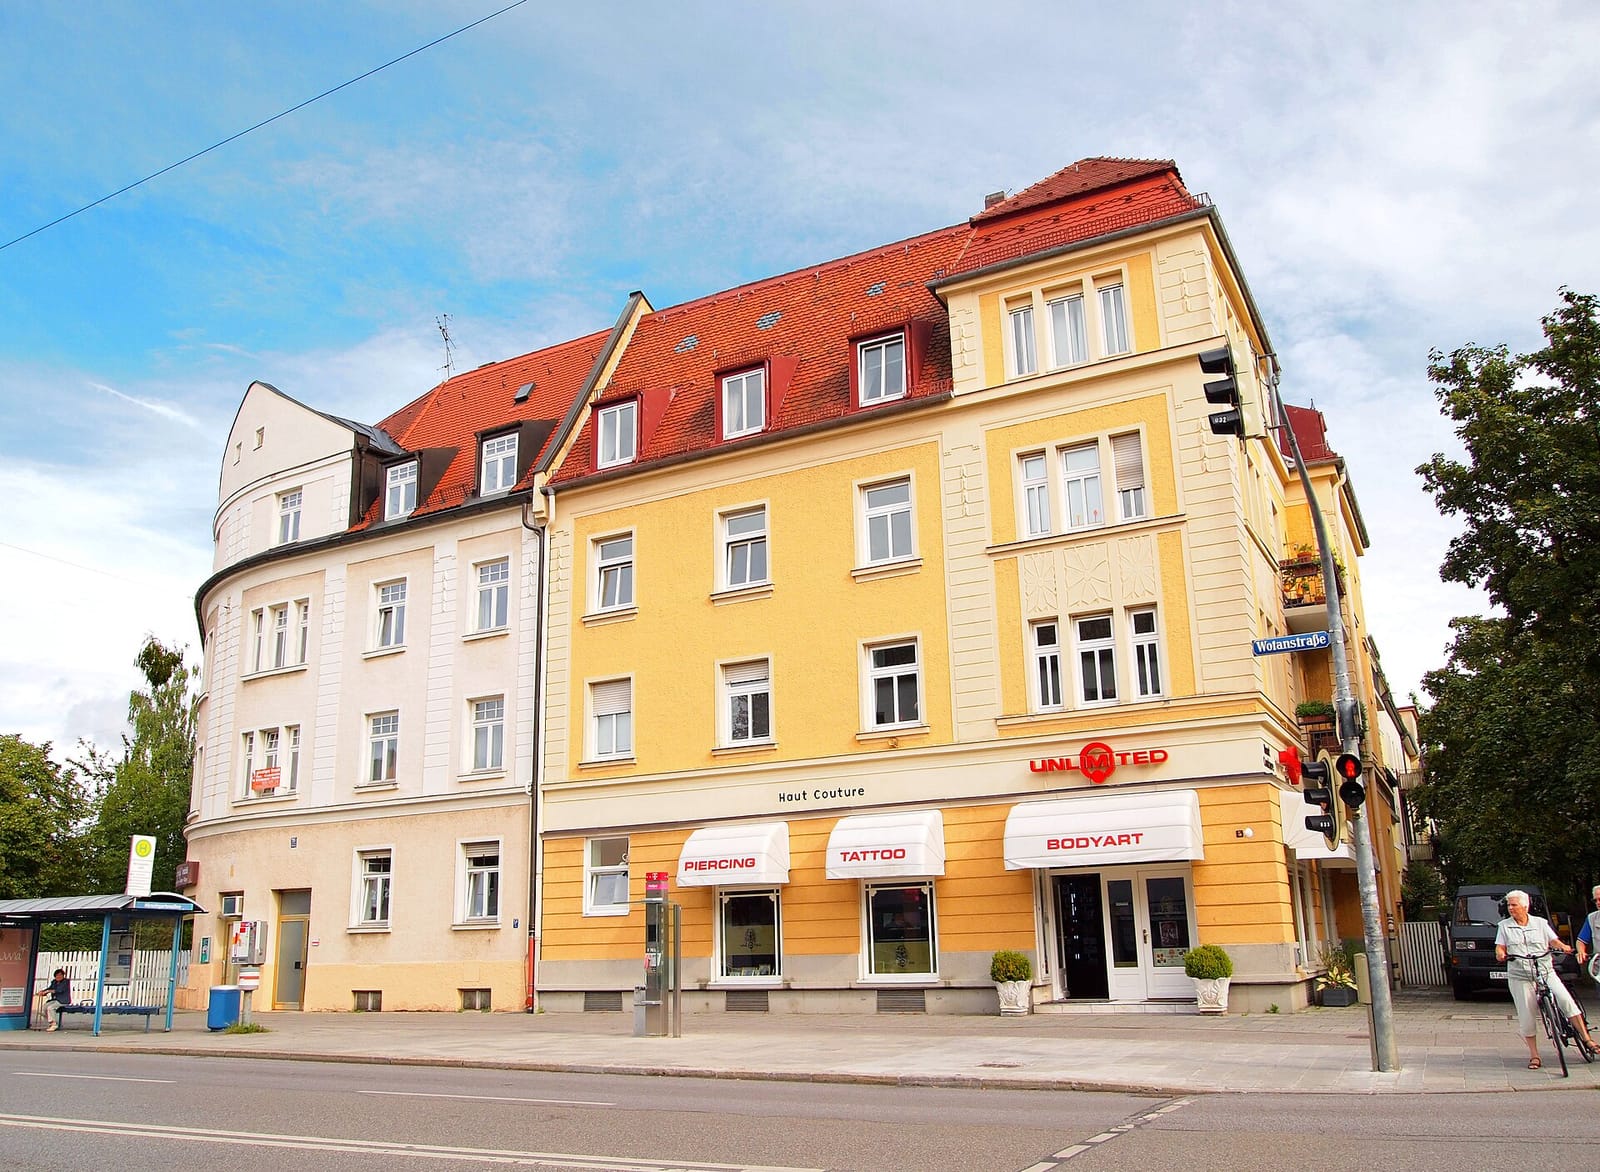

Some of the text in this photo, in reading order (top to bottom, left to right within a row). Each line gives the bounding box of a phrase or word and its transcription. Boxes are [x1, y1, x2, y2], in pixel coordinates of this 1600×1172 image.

[1256, 634, 1327, 653] Wotanstraße
[778, 787, 865, 802] Haut Couture
[1046, 832, 1144, 850] BODYART
[839, 848, 906, 862] TATTOO
[684, 857, 756, 872] PIERCING
